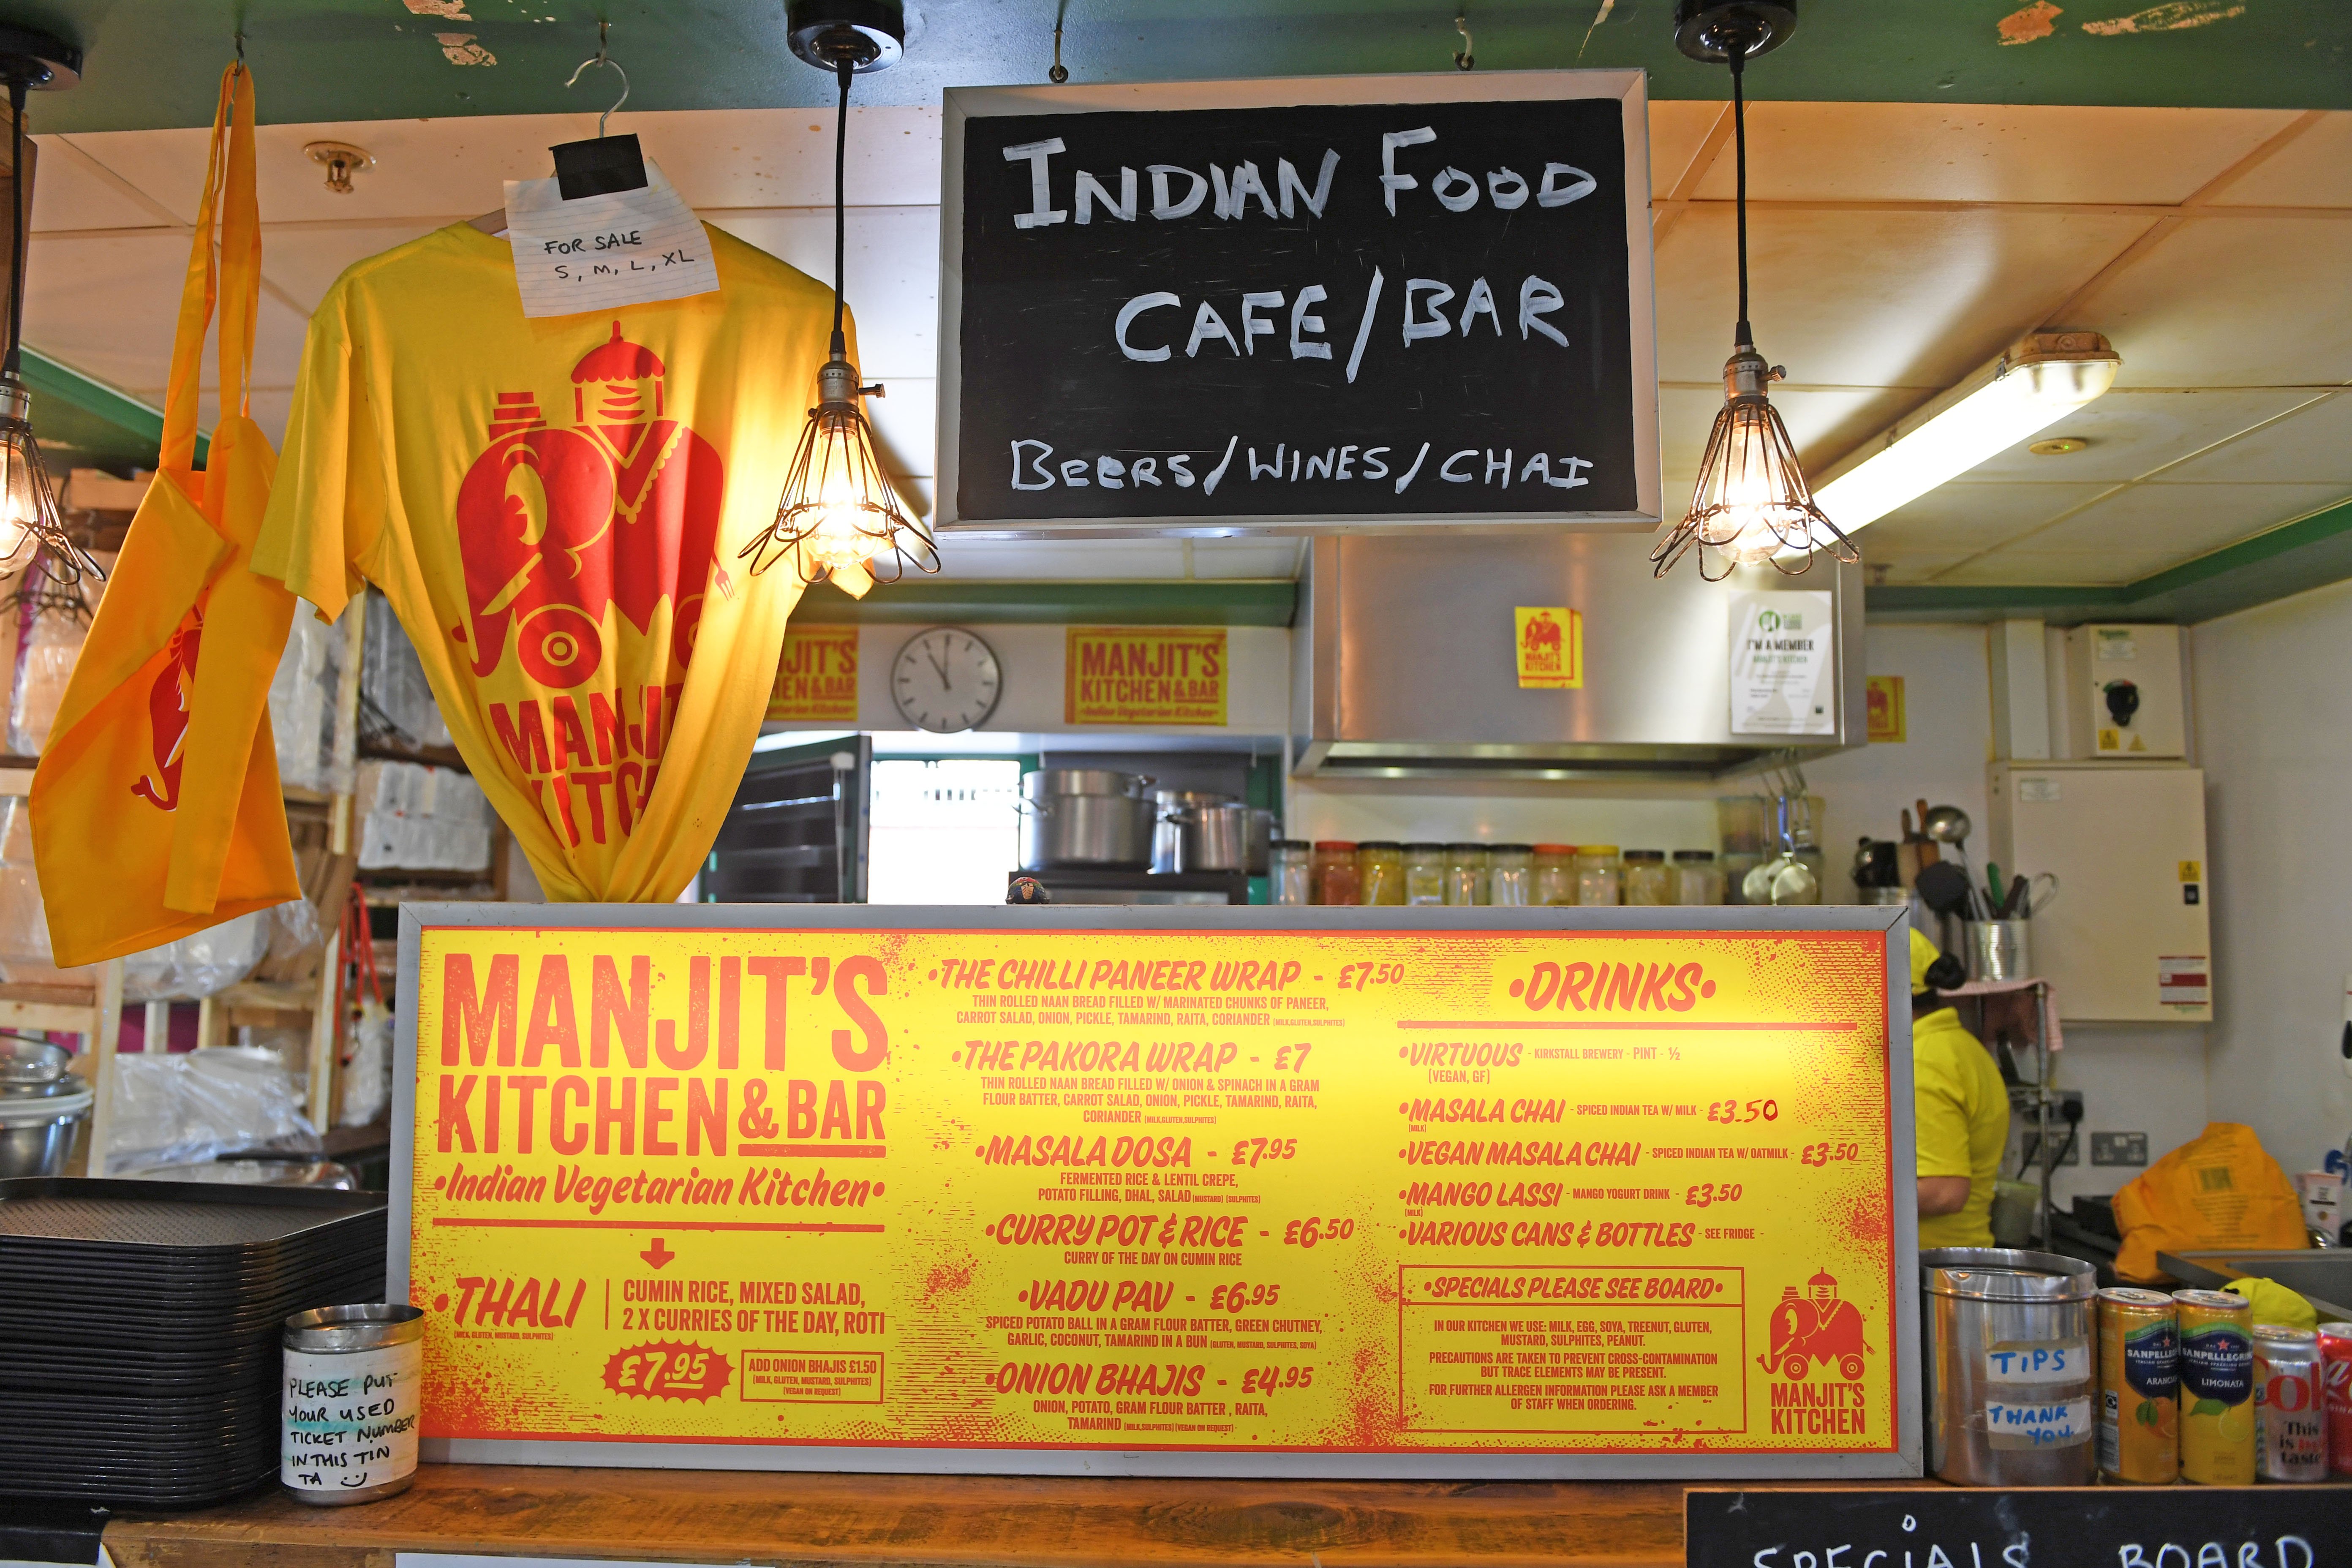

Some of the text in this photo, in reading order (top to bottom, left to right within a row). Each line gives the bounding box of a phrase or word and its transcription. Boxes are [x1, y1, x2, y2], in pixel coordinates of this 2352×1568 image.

[1003, 137, 1340, 229] INDIAN
[544, 230, 642, 254] FOR SALE
[662, 249, 694, 266] XL
[1082, 642, 1220, 678] MANJIT'S
[1081, 679, 1171, 702] KITCHEN
[1188, 680, 1219, 696] BAR
[940, 959, 1405, 991] THE CHILLI PANEER WRAP £7.50
[1525, 962, 1701, 1012] DRINKS
[441, 953, 889, 1072] MANJIT'S
[957, 1011, 996, 1024] CARROT
[1000, 1012, 1034, 1025] SALAD,
[1038, 1012, 1072, 1025] ONION,
[1076, 1012, 1114, 1026] PICKLE,
[1118, 1013, 1173, 1026] TAMARIND,
[1177, 1013, 1209, 1026] RAITA,
[1212, 1013, 1270, 1025] CORIANDER
[964, 1040, 1311, 1073] THE PAKORA WRAP £7
[1410, 1043, 1523, 1067] VIRTUOUS
[1534, 1048, 1580, 1059] KIRKSTALL
[1582, 1048, 1623, 1059] BREWERY
[1633, 1047, 1657, 1060] PINT
[1429, 1068, 1490, 1084] (VEGAN, GF)
[438, 1074, 729, 1156] KITCHEN
[787, 1080, 886, 1140] BAR
[1083, 1110, 1141, 1123] CORIANDER
[1409, 1098, 1504, 1122] MASALA
[1511, 1099, 1566, 1123] CHAI
[1577, 1105, 1608, 1115] SPICED
[1610, 1105, 1640, 1115] INDIAN
[1642, 1105, 1658, 1116] TEA
[1661, 1104, 1673, 1116] W/
[1675, 1105, 1696, 1116] MILK
[985, 1135, 1297, 1168] MASALA DOSA £7.95
[1408, 1141, 1859, 1167] VEGAN MASALA CHAI £3.50
[446, 1162, 870, 1215] Indian Vegetarian Kitchen
[1038, 1188, 1076, 1201] POTATO
[1080, 1189, 1122, 1203] FILLING,
[1125, 1189, 1154, 1203] DHAL,
[1158, 1190, 1191, 1202] SALAD
[1406, 1182, 1742, 1208] MANGO LASSI MANGO YOGURT DRINK £3.50
[996, 1213, 1354, 1249] CURRY POT & RICE £6.50
[1408, 1221, 1508, 1246] VARIOUS
[1511, 1222, 1574, 1247] CANS
[1595, 1222, 1696, 1247] BOTTLES
[1705, 1228, 1721, 1239] SEE
[1724, 1228, 1755, 1239] FRIDGE
[624, 1279, 865, 1308] CUMIN RICE, MIXED SALAD,
[1029, 1280, 1280, 1314] VADU PAV £6.95
[1432, 1277, 1714, 1299] SPECIALS PLEASE SEE BOARD
[455, 1277, 587, 1328] THALI
[623, 1308, 885, 1337] 2 X CURRIES OF THE DAY, ROTI
[619, 1352, 707, 1390] £7.95
[749, 1358, 877, 1374] ADD ONION BHAJIS £1.50
[290, 1378, 350, 1398] PLEASE
[997, 1362, 1314, 1397] ONION BHAJIS £4.95
[2202, 1377, 2244, 1388] LIMONATA
[1771, 1383, 1865, 1407] MANJIT'S
[289, 1399, 395, 1424] YOUR USED
[1772, 1408, 1865, 1434] KITCHEN
[1989, 1405, 2068, 1425] THANK
[290, 1431, 347, 1445] TICKET
[292, 1454, 308, 1467] IN
[311, 1454, 348, 1467] THIS
[298, 1472, 322, 1486] TA
